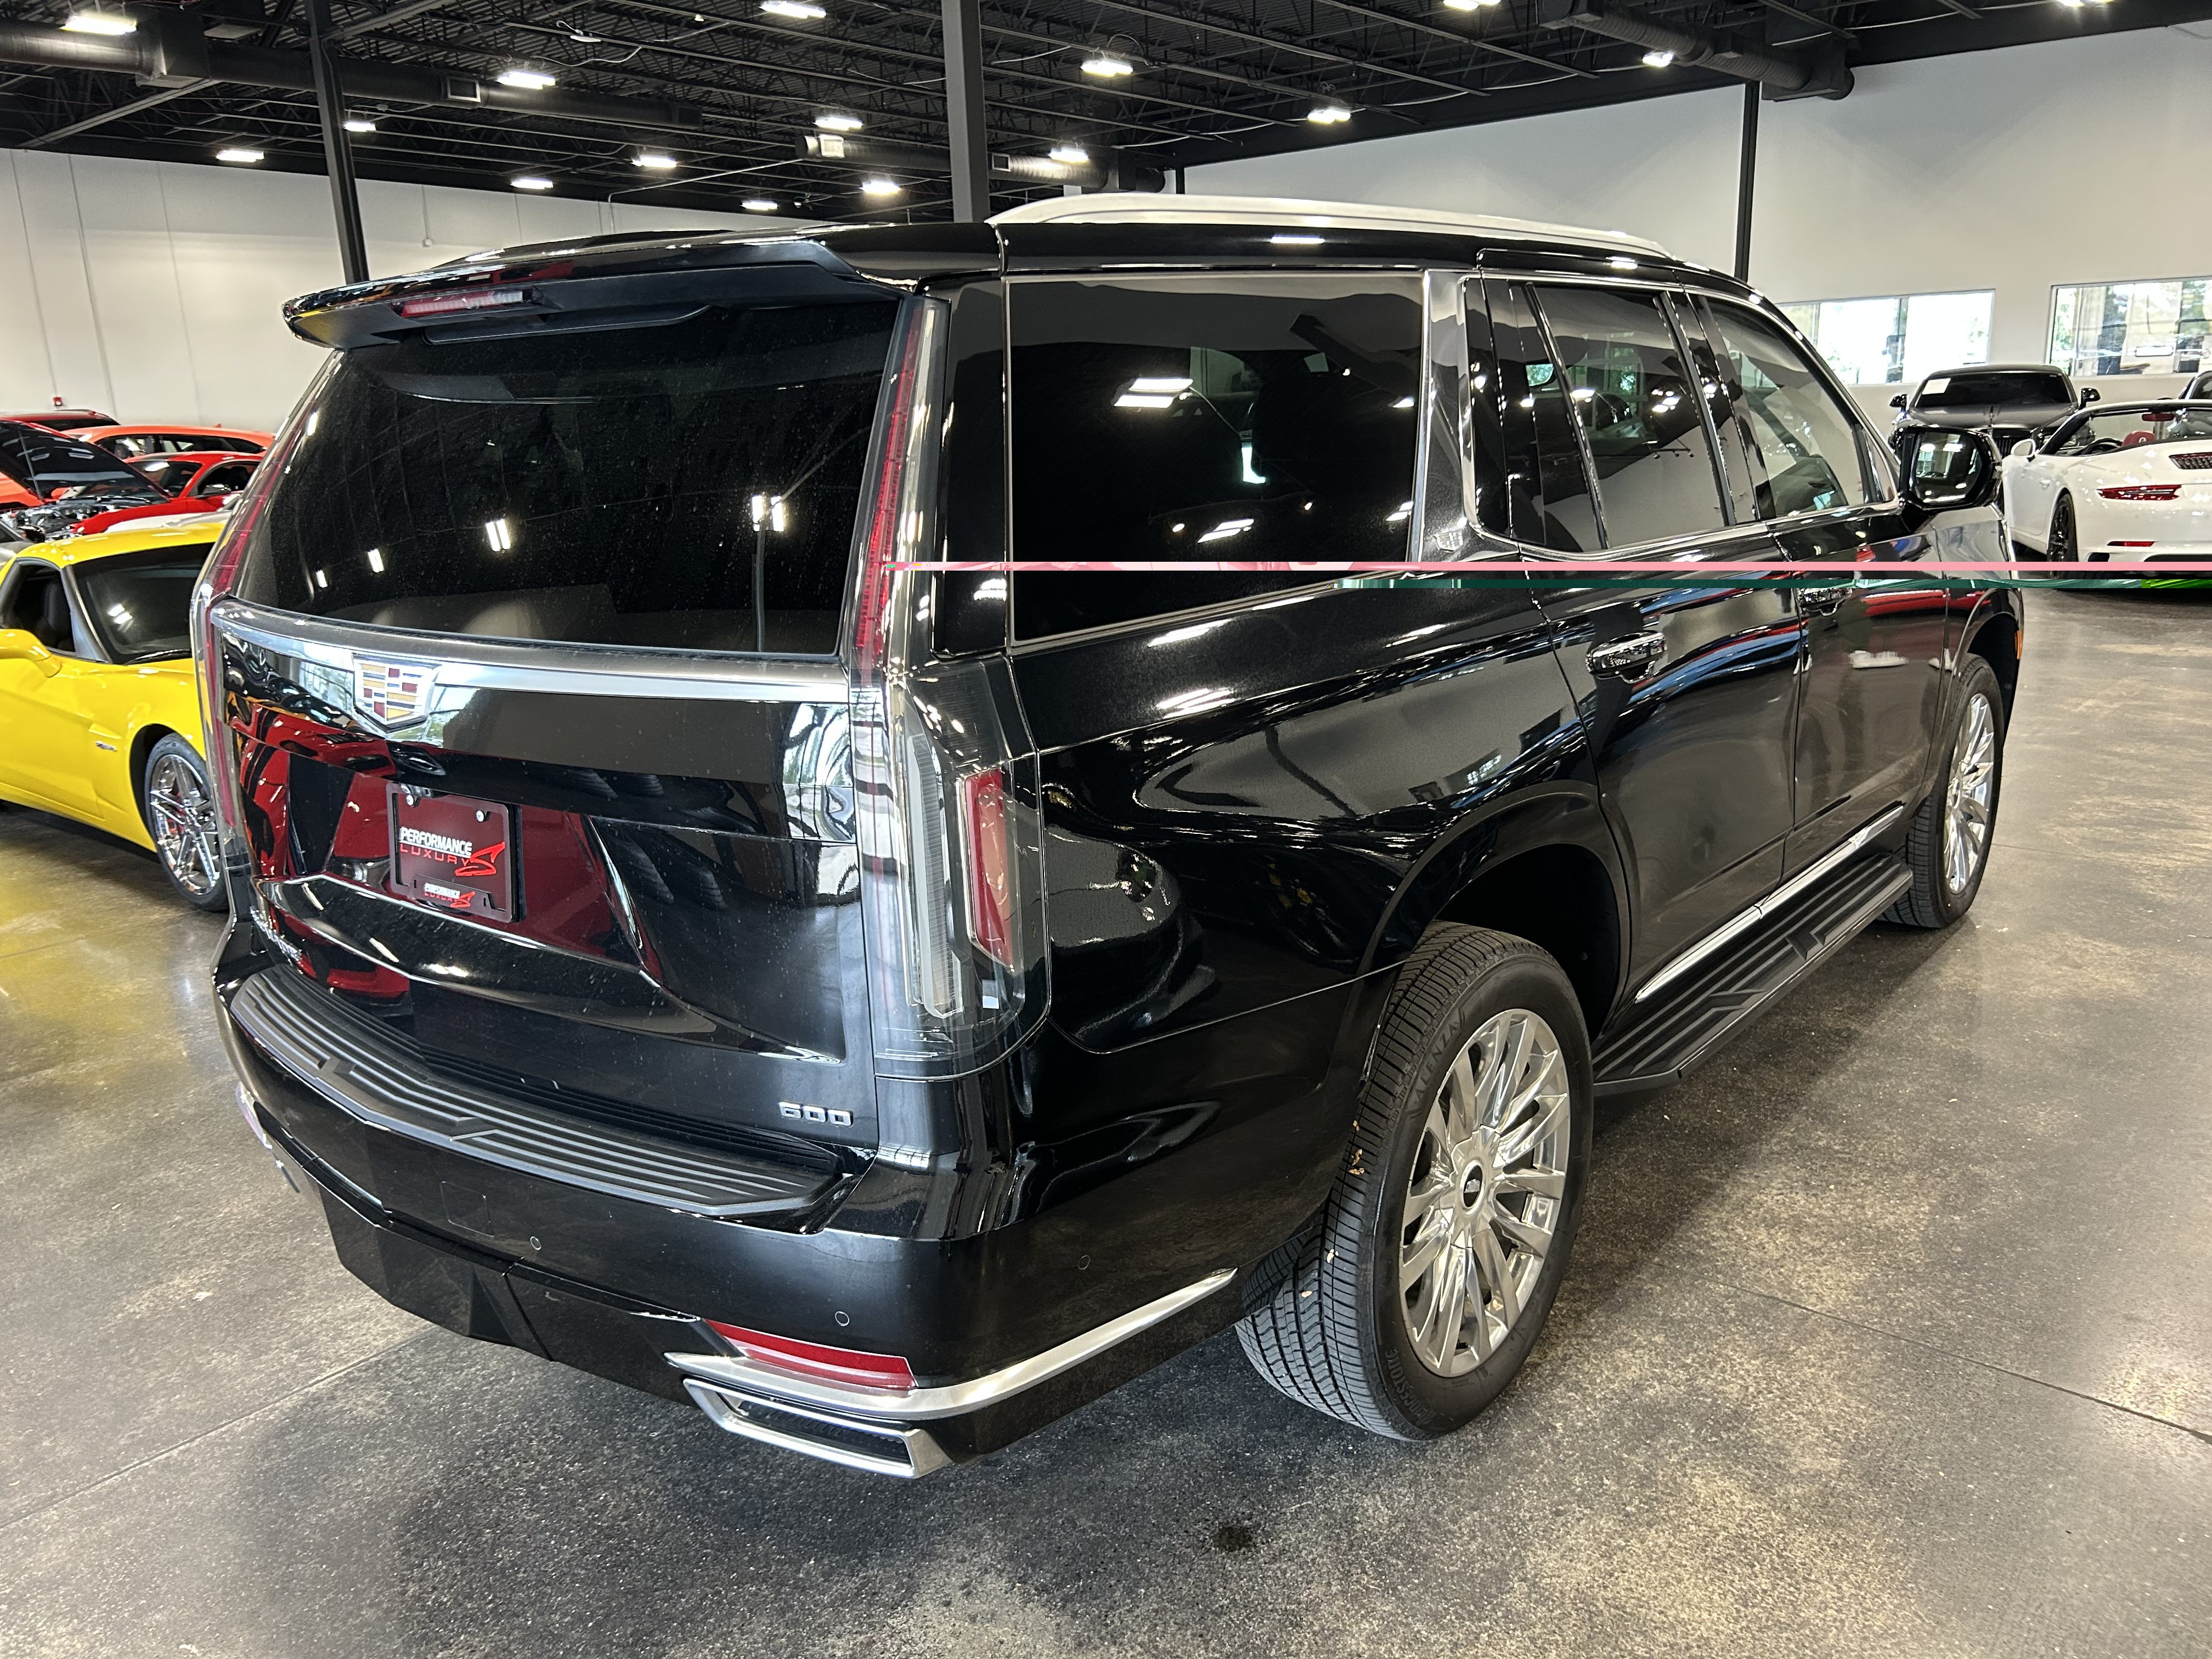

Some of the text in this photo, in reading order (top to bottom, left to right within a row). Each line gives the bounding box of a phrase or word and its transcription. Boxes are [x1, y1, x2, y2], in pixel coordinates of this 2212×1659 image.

[400, 826, 472, 856] PERFORMANCE
[400, 843, 470, 867] LUXURY
[1415, 1023, 1457, 1101] ALENZA
[778, 1101, 853, 1126] 600
